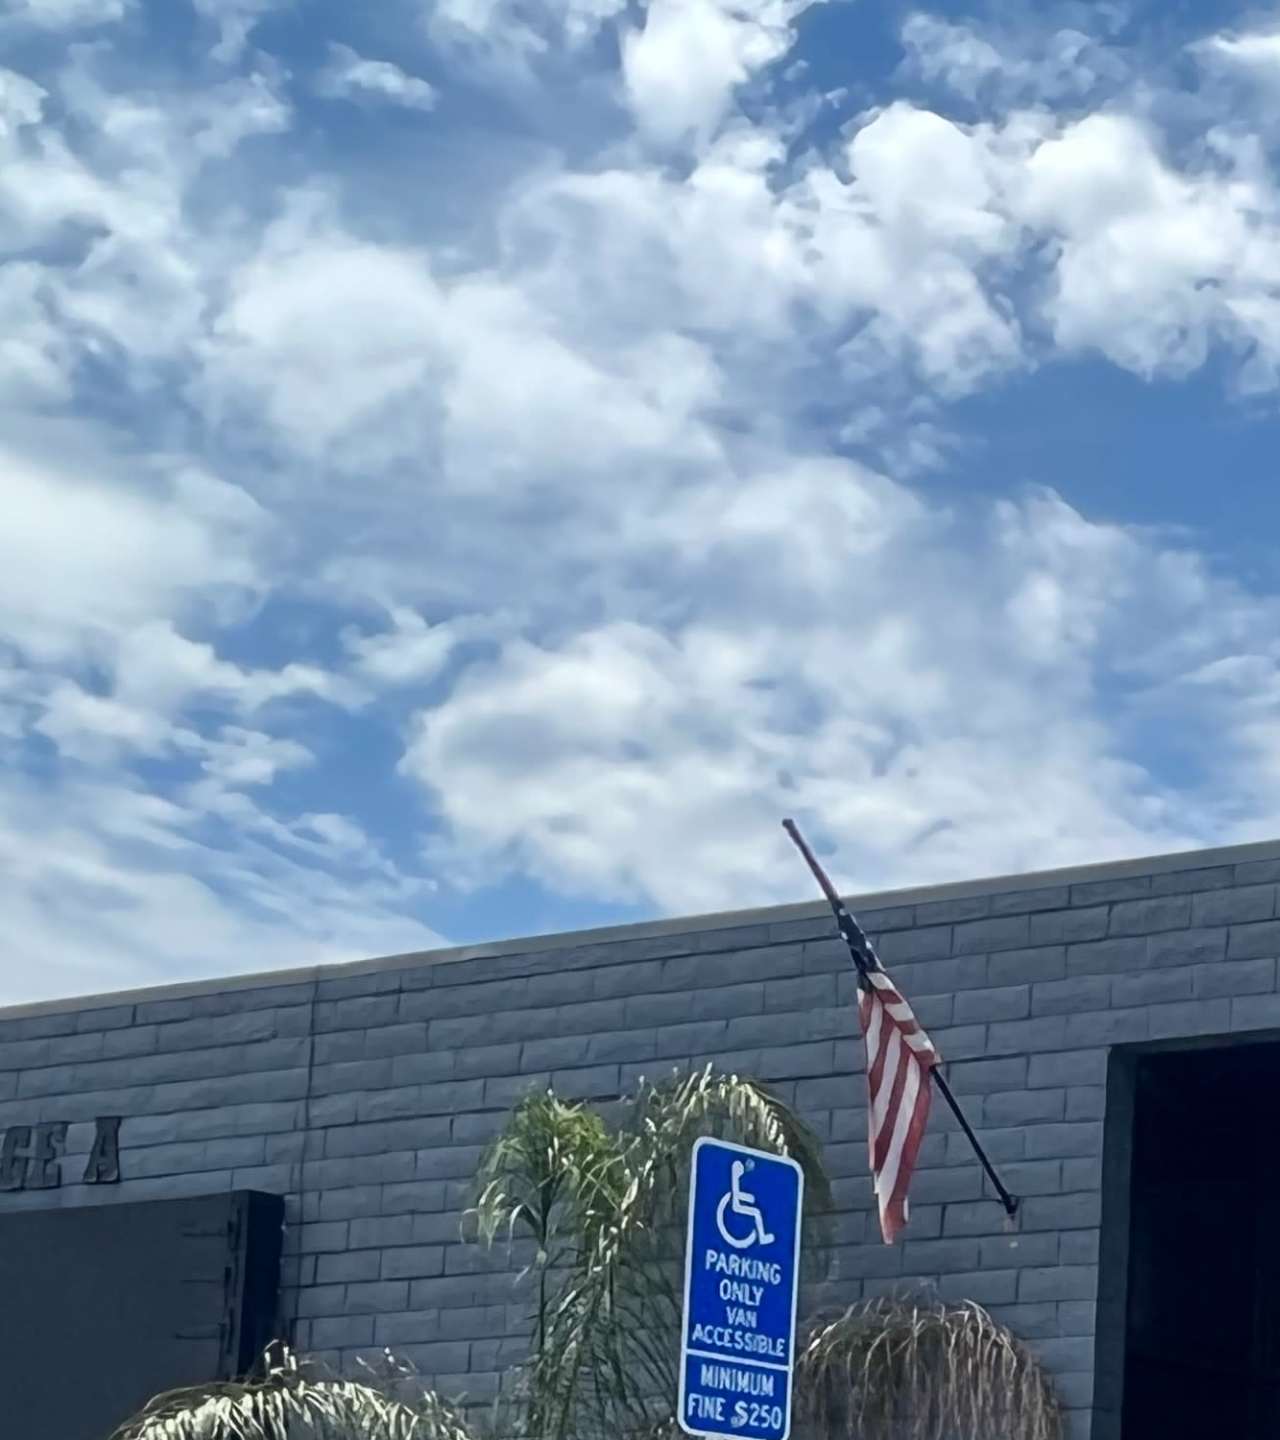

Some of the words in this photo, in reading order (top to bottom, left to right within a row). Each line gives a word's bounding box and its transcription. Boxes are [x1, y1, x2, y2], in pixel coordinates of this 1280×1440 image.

[83, 1116, 122, 1184] A
[705, 1250, 781, 1285] PARKING
[720, 1279, 763, 1306] ONLY
[726, 1307, 757, 1329] VAN
[692, 1324, 785, 1356] ACCESSIBLE
[701, 1364, 774, 1397] MINIMUM
[688, 1393, 726, 1421] FINE
